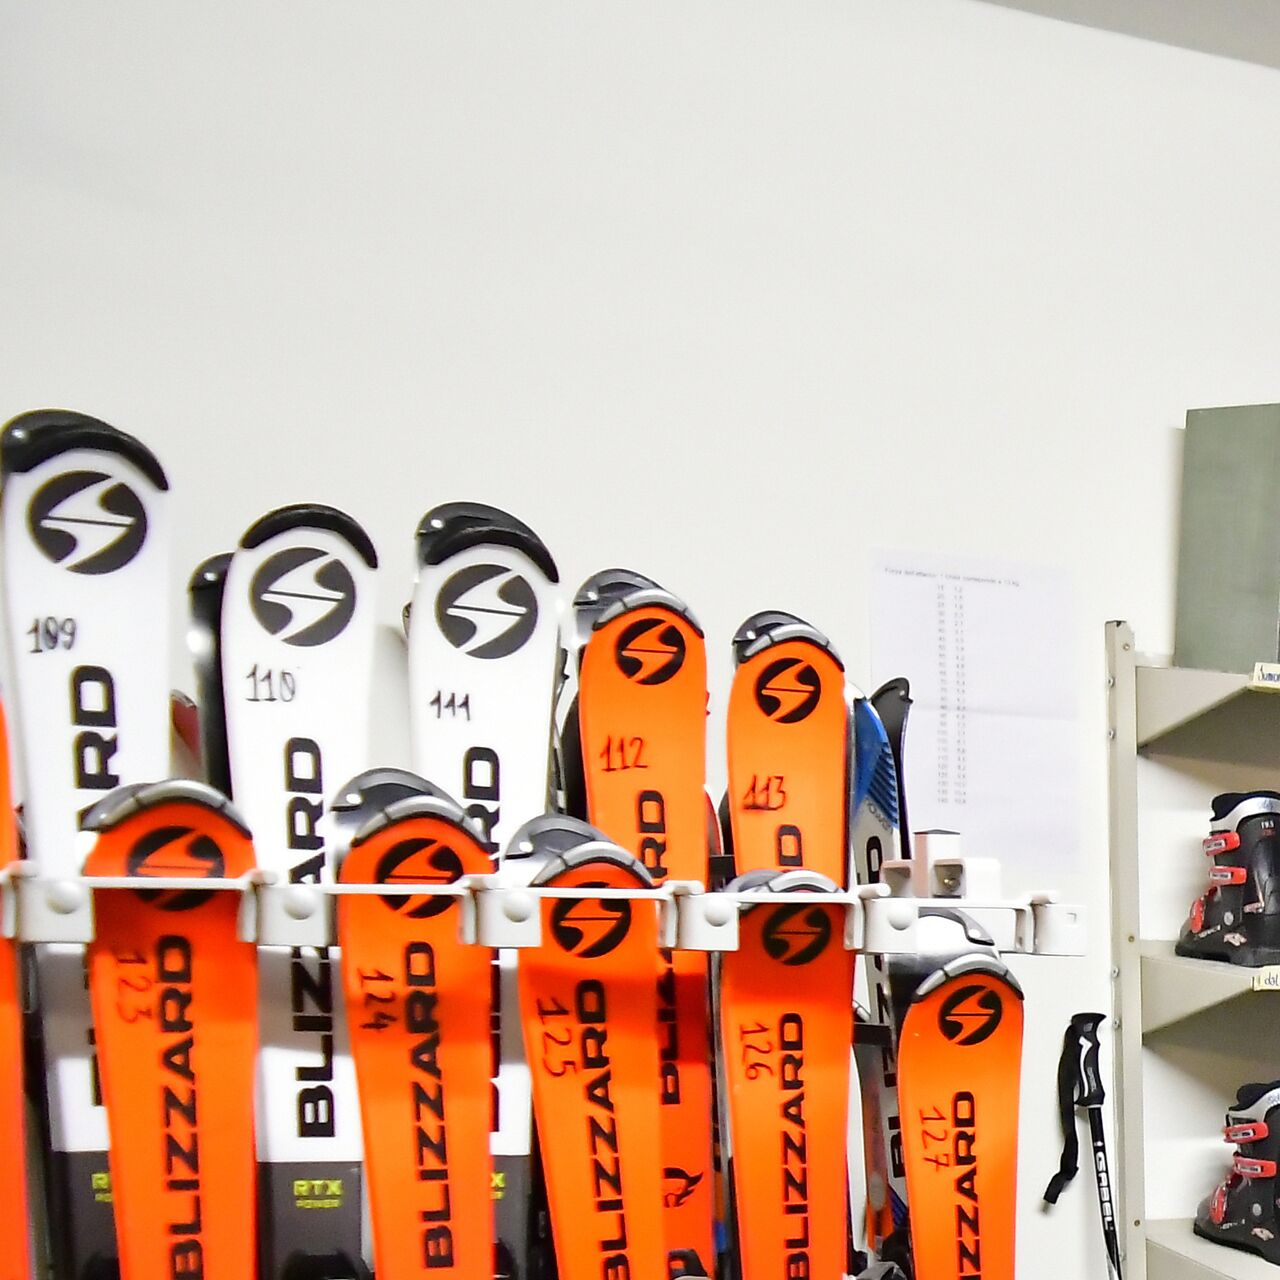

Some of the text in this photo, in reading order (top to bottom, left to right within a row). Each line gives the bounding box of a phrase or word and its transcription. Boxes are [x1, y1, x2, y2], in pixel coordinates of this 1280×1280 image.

[26, 616, 77, 653] 109
[246, 663, 297, 702] 110
[430, 690, 470, 721] 111
[599, 735, 649, 772] 112
[743, 774, 786, 811] 113
[116, 950, 154, 1024] 123
[537, 996, 577, 1077] 125
[740, 1021, 773, 1081] 126
[405, 941, 455, 1268] BLIZZARD
[918, 1104, 952, 1174] 127
[293, 1179, 343, 1196] RTX
